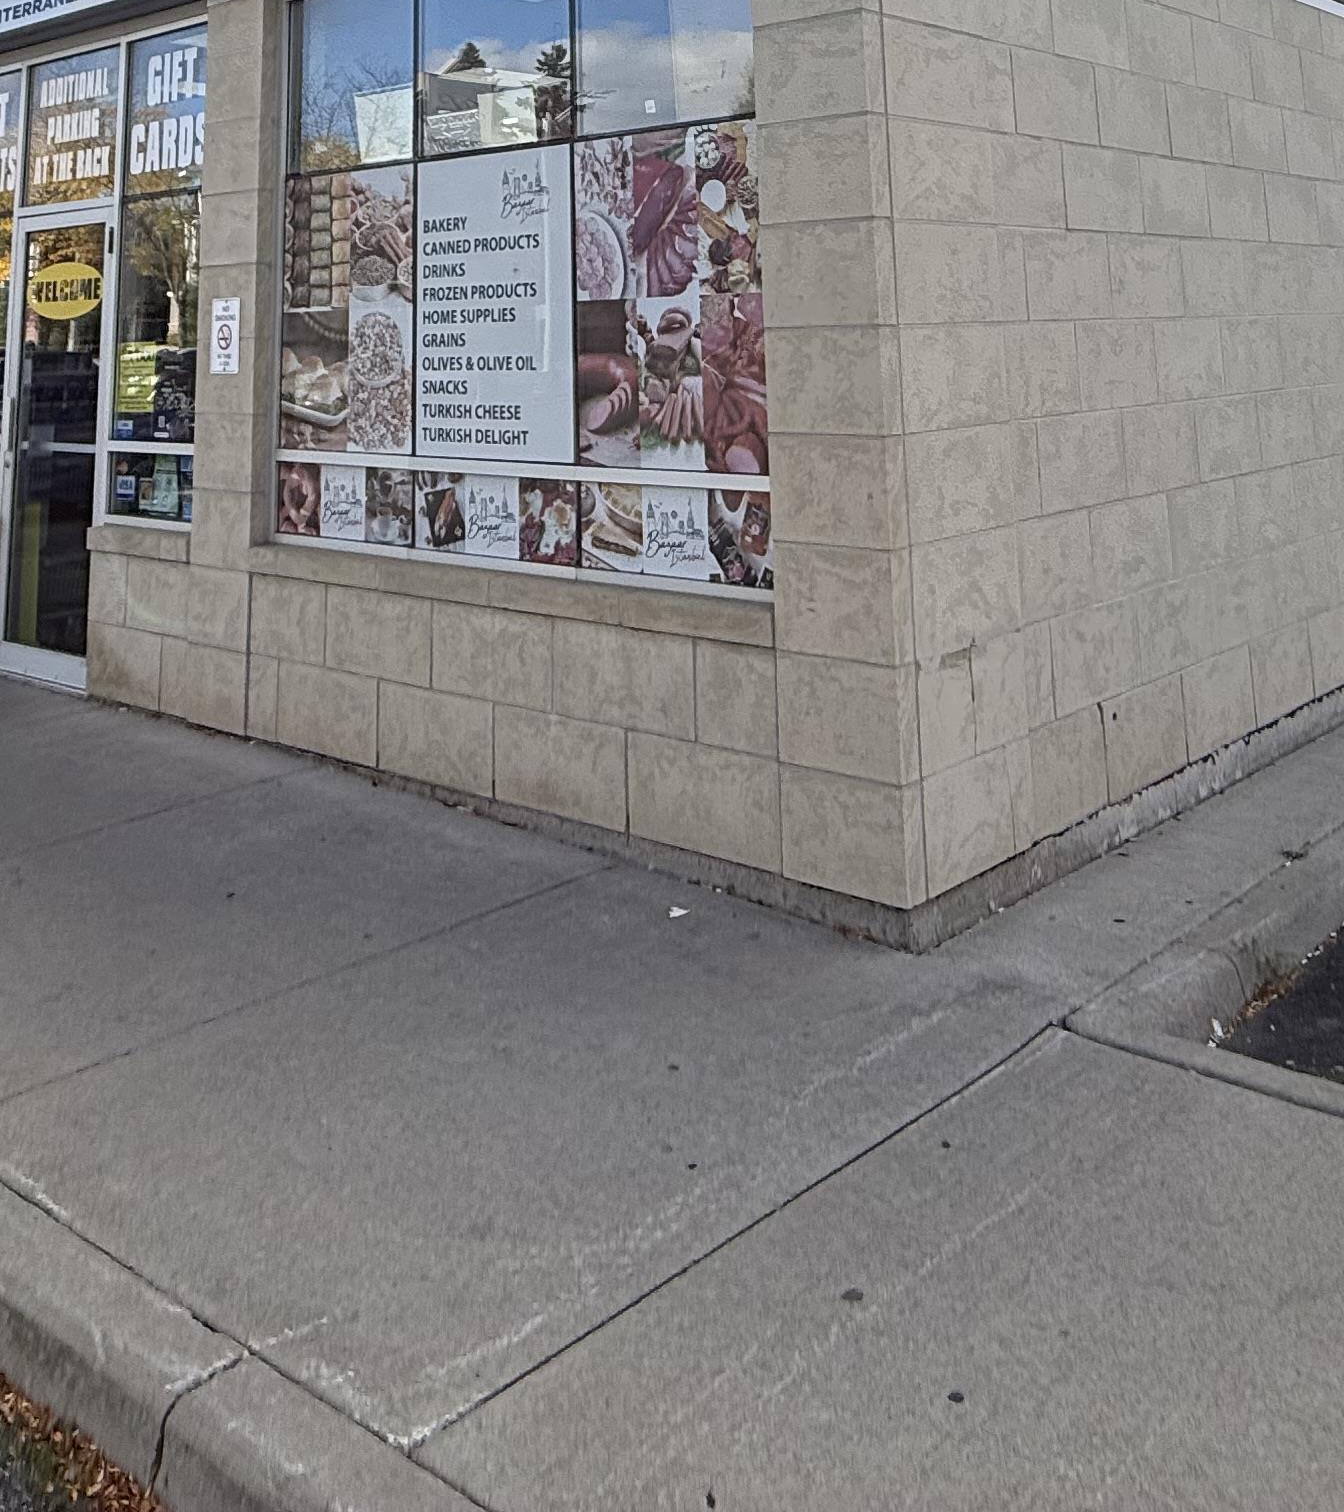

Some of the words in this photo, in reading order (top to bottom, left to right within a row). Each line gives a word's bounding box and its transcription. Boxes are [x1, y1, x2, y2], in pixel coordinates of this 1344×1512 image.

[147, 47, 198, 106] GIFT
[40, 68, 108, 108] ADDITIONAL
[47, 108, 101, 145] PARKING
[129, 112, 205, 175] CARDS
[33, 155, 49, 185] AT
[52, 150, 74, 182] THE
[76, 146, 111, 179] BACK
[422, 216, 468, 234] BAKERY
[422, 239, 471, 256] CANNED
[474, 234, 540, 253] PRODUCTS
[422, 262, 466, 279] DRINKS
[31, 277, 101, 303] WELCOME
[422, 286, 468, 302] FROZEN
[471, 282, 537, 300] PRODUCTS
[422, 309, 457, 325] HOME
[460, 307, 516, 324] SUPPLIES
[422, 333, 466, 348] GRAINS
[422, 356, 463, 372] OLIVES
[466, 356, 474, 371] &
[477, 356, 513, 372] OLIVE
[516, 355, 537, 371] OIL
[422, 380, 468, 396] SNACKS
[422, 403, 472, 420] TURKISH
[475, 404, 521, 421] CHEESE
[422, 426, 472, 445] TURKISH
[475, 429, 529, 447] DELIGHT
